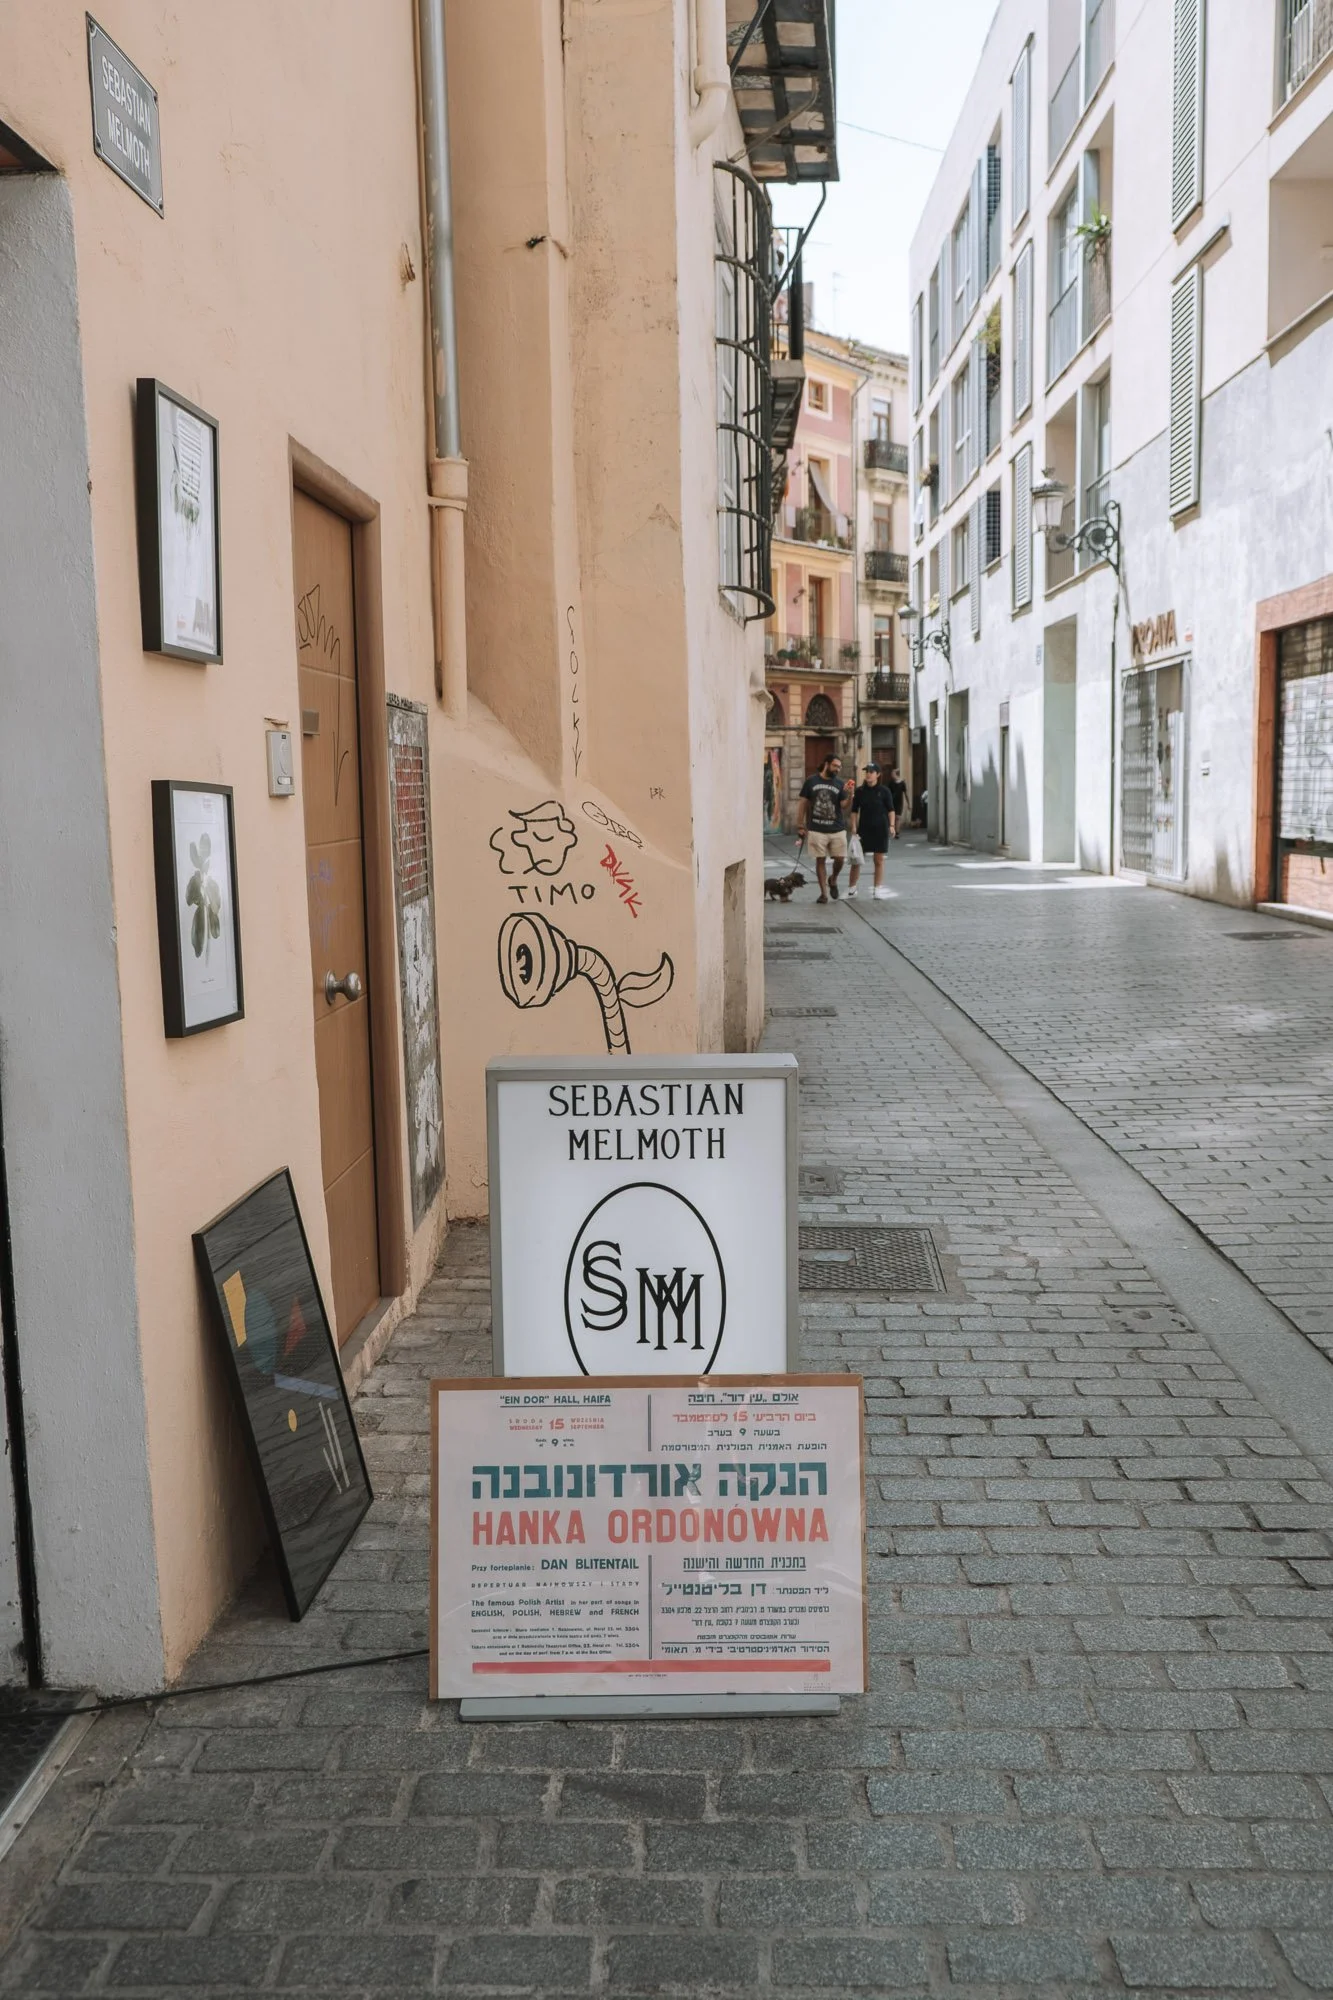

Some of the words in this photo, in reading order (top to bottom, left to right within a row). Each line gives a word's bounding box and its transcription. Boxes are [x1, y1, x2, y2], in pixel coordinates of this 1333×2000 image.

[101, 56, 150, 136] SEBASTIAN
[106, 107, 150, 179] MELMOTH
[508, 882, 595, 906] TIMO
[548, 1083, 744, 1117] SEBASTIAN
[568, 1128, 725, 1160] MELMOTH
[553, 1395, 580, 1405] HALL,
[583, 1394, 611, 1404] HAIFA
[688, 1394, 715, 1403] חיפה
[772, 1393, 799, 1402] אולם
[733, 1411, 748, 1422] 15
[794, 1412, 817, 1422] ביום
[549, 1418, 565, 1430] 15
[739, 1428, 747, 1437] 9
[551, 1438, 559, 1447] 9
[716, 1443, 753, 1451] הפולנית
[758, 1443, 792, 1451] האמנית
[471, 1463, 703, 1500] אורדונובנה
[718, 1461, 828, 1501] הנקה
[471, 1508, 586, 1546] HANKA
[607, 1503, 830, 1544] ORDONÓWNA
[541, 1559, 568, 1570] DAN
[575, 1558, 640, 1570] BLITENTAIL
[683, 1557, 719, 1570] והישנה
[725, 1556, 765, 1569] החדשה
[771, 1556, 807, 1569] בתכנית
[750, 1582, 767, 1597] דן
[519, 1598, 541, 1606] Polish
[471, 1609, 505, 1618] ENGLISH,
[512, 1609, 542, 1617] POLISH,
[611, 1608, 640, 1616] FRENCH
[800, 1645, 830, 1653] הסידור
